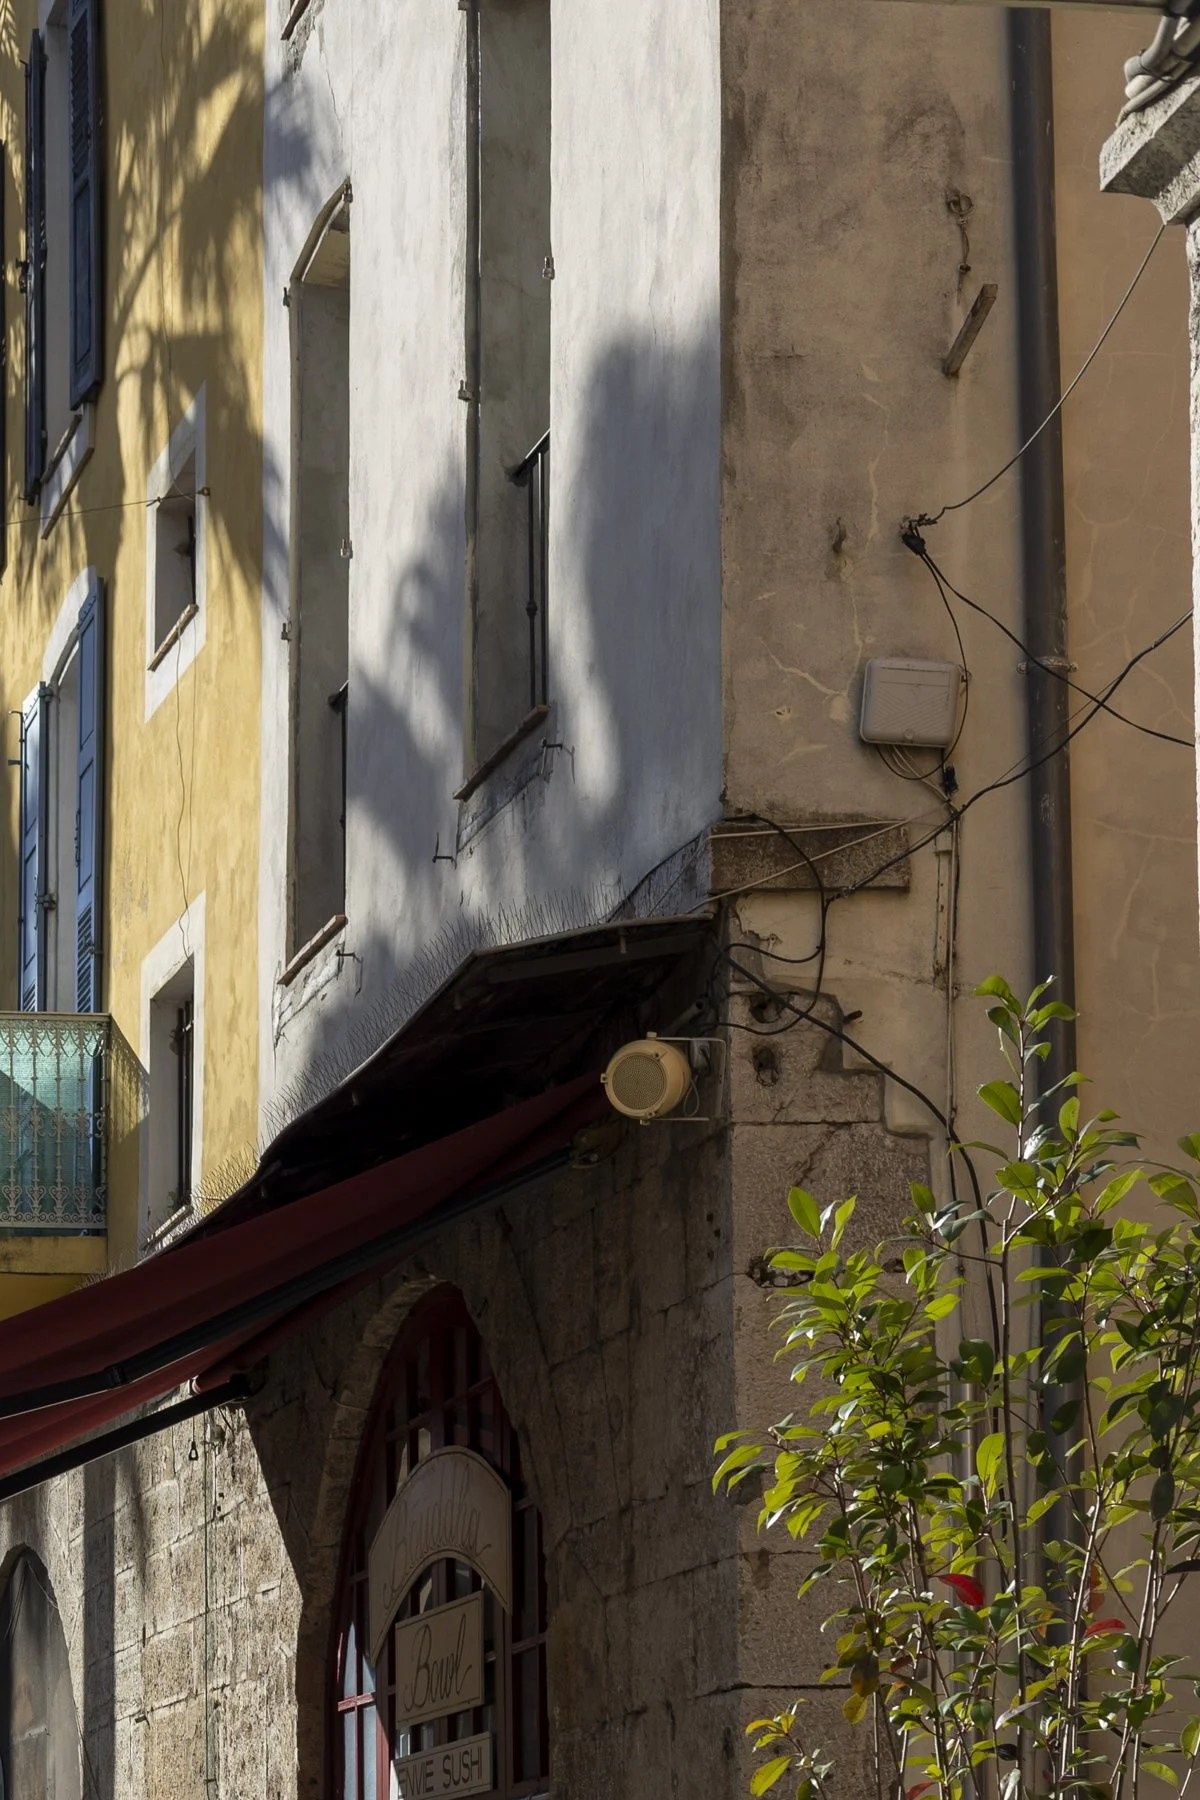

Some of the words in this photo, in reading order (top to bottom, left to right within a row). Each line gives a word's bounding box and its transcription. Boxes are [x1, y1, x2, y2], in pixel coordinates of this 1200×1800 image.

[404, 1613, 473, 1713] Bowl
[398, 1760, 435, 1799] ENVIE
[442, 1746, 483, 1789] SUSHI
